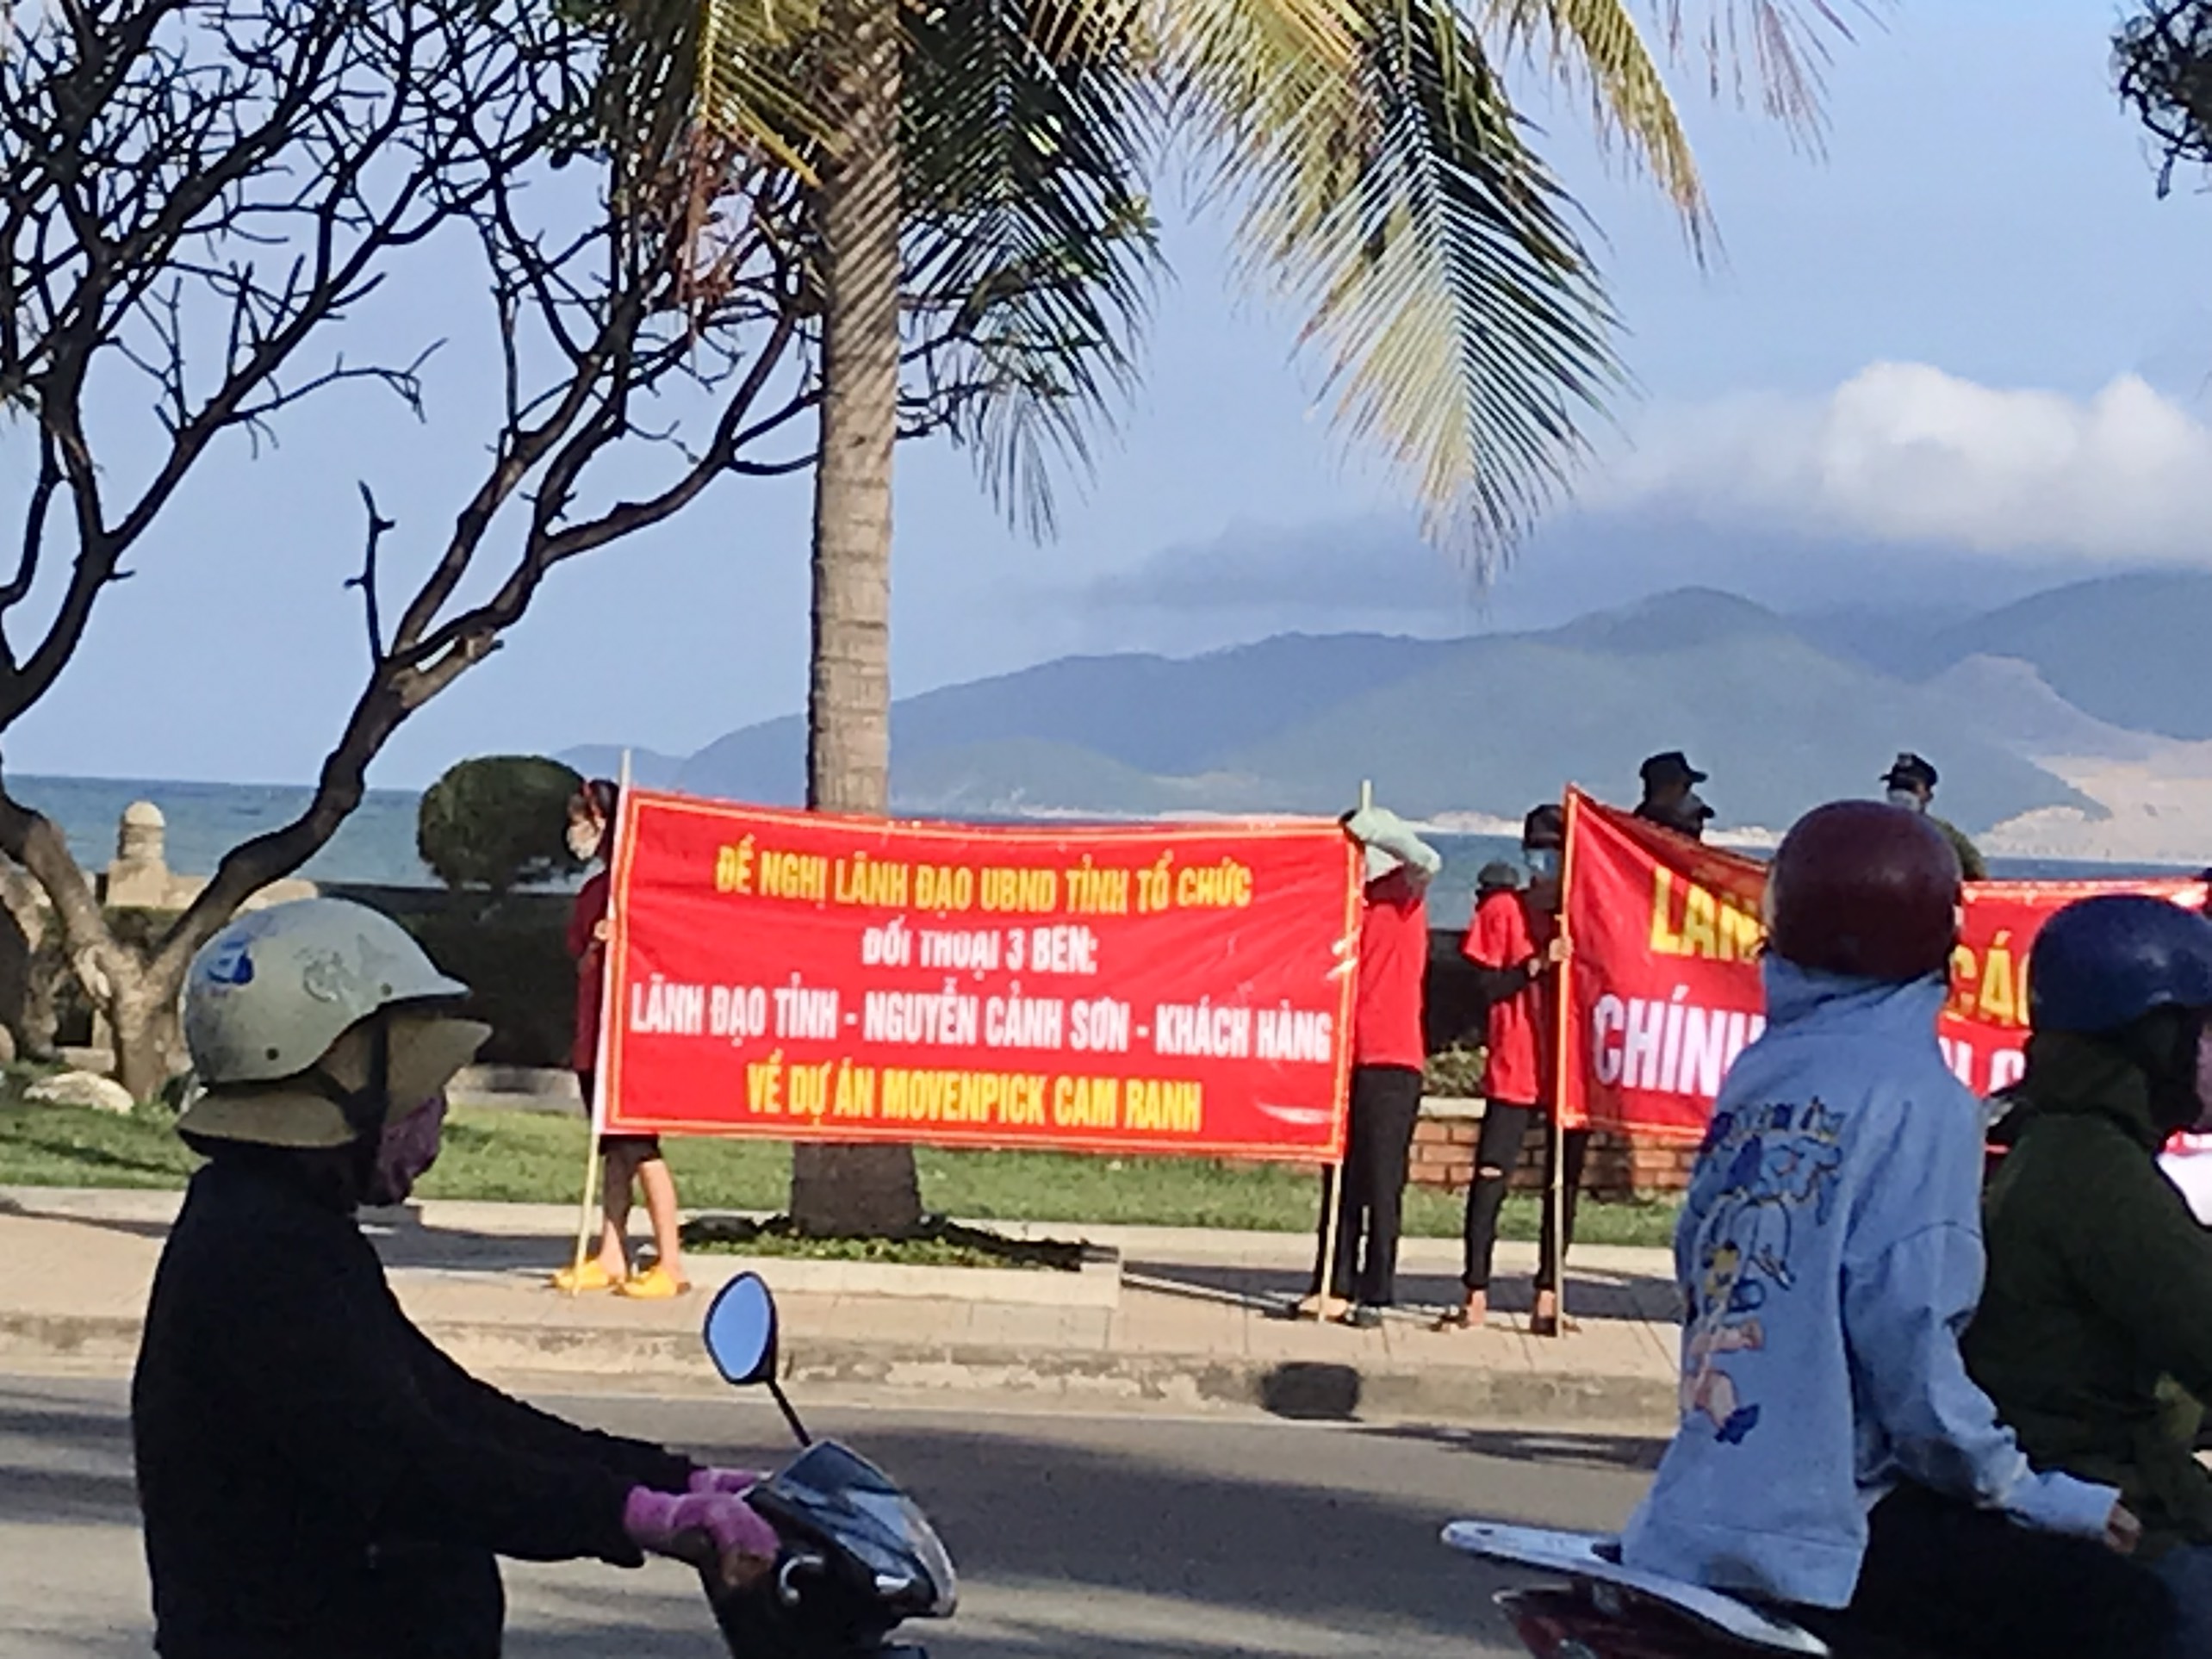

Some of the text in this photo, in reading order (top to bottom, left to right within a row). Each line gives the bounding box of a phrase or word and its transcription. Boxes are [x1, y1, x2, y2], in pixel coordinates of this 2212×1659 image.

[760, 850, 827, 910] NGHỊ
[835, 851, 908, 907] LÃNH
[915, 864, 972, 918] ĐẠO
[980, 867, 1057, 914] UBND
[1066, 854, 1129, 915] TỈNH
[1137, 848, 1175, 914] TỔ
[1177, 855, 1252, 908] CHỨC
[862, 914, 911, 967] ĐỐI
[919, 929, 1000, 980] THOẠI
[1006, 928, 1024, 971] 3
[1948, 929, 2029, 1027] CÁ
[630, 974, 705, 1034] LÃNH
[709, 985, 766, 1047] ĐẠO
[774, 972, 838, 1039] TỈNH
[844, 1012, 858, 1025] -
[864, 977, 979, 1047] NGUYỄN
[985, 980, 1063, 1050] CẢNH
[1069, 997, 1130, 1053] SƠN
[1136, 1025, 1149, 1037] -
[1155, 994, 1251, 1059] KHÁCH
[788, 1060, 832, 1128] DỰ
[832, 1057, 875, 1118] ÁN
[881, 1068, 1047, 1126] MOVENPICK
[1053, 1076, 1119, 1127] CAM
[1124, 1080, 1202, 1132] RANH
